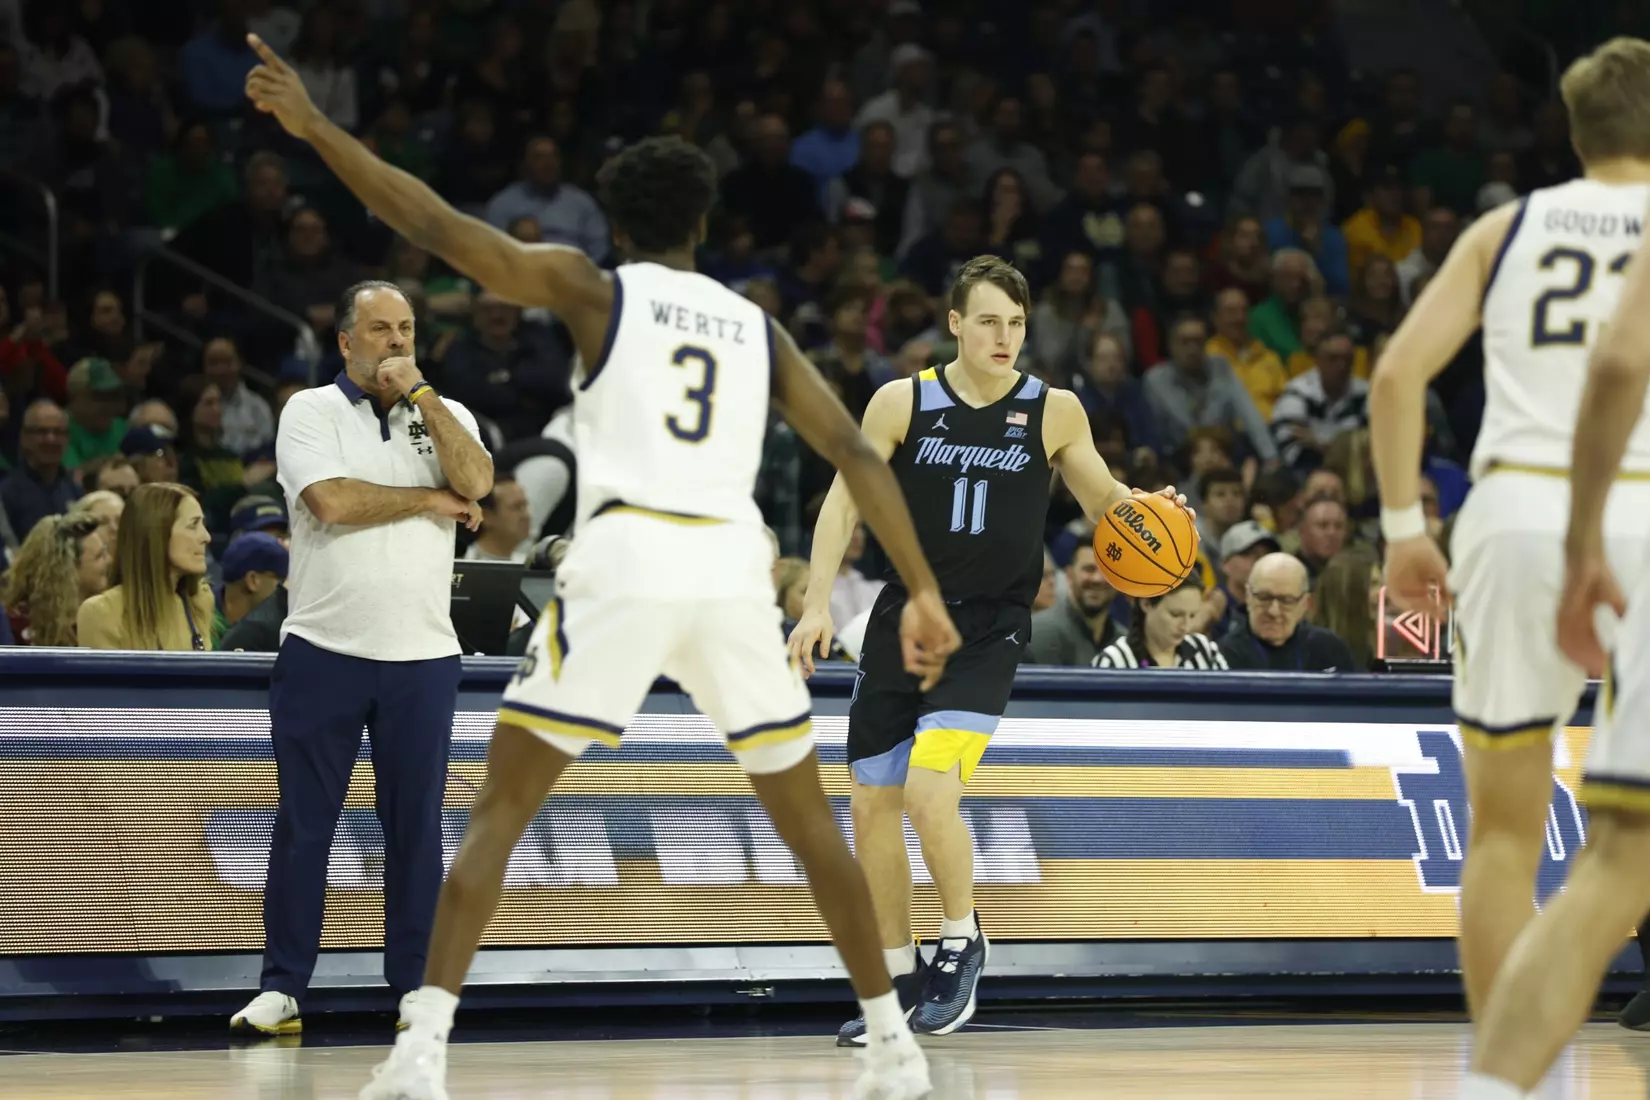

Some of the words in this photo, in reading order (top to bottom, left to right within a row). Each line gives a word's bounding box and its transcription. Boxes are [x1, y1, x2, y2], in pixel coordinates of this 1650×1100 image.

[650, 300, 745, 345] WERTZ
[1531, 244, 1633, 349] 2
[665, 344, 718, 445] 3
[914, 436, 1031, 473] Marquette
[950, 477, 988, 535] 11
[1113, 502, 1162, 554] Wilson
